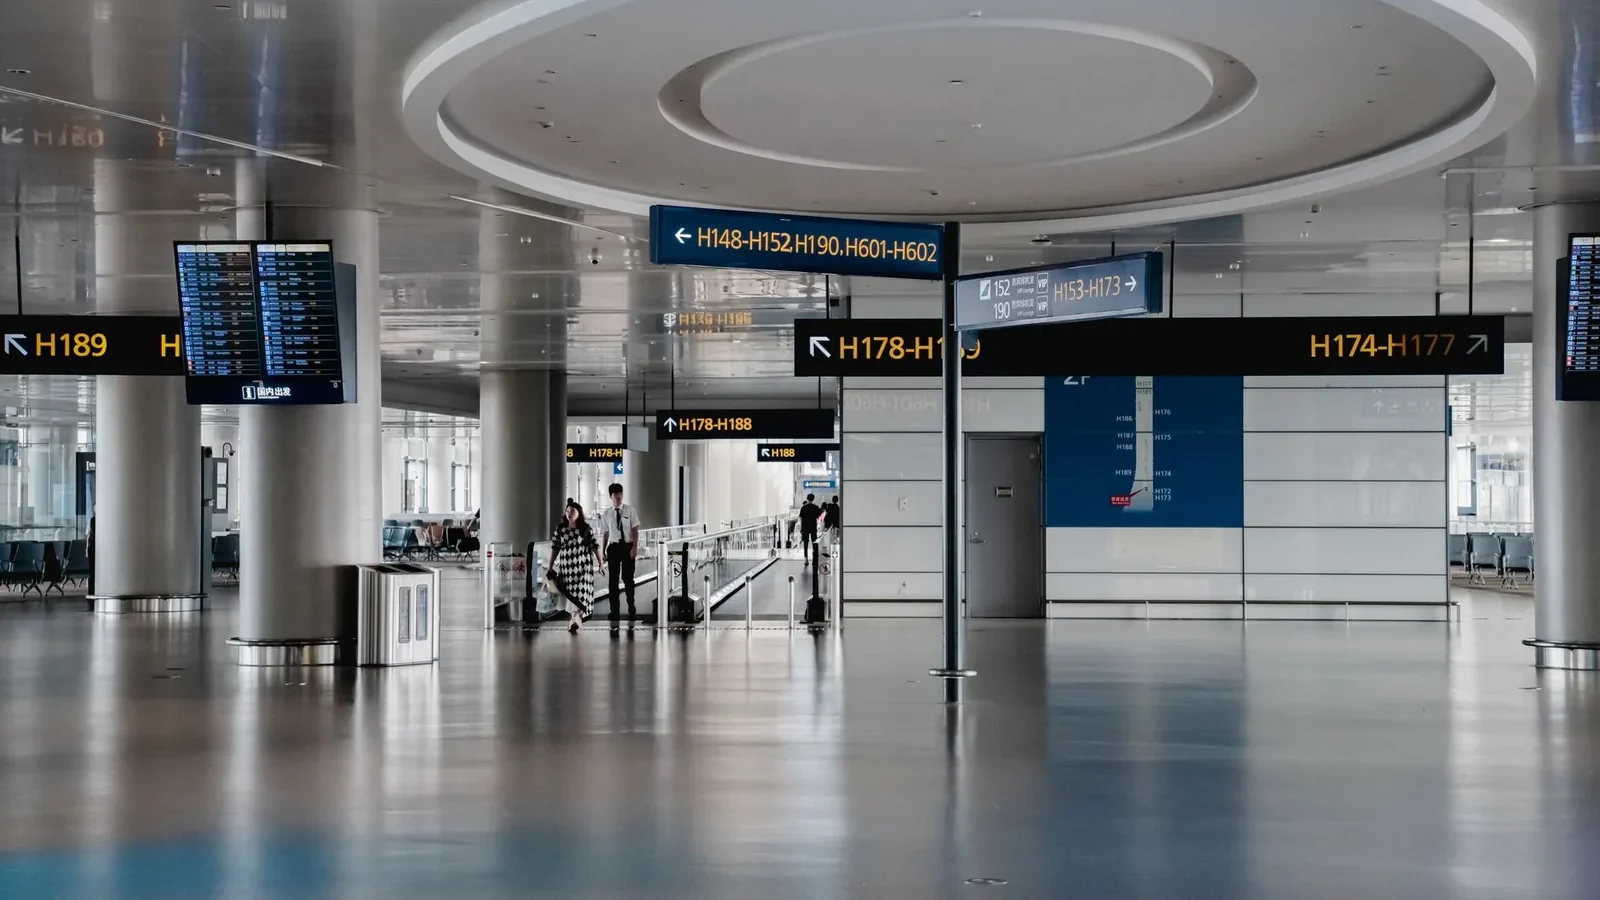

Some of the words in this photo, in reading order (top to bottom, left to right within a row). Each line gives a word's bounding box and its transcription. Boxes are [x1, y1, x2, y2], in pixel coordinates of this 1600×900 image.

[994, 279, 1010, 297] 152
[1037, 278, 1048, 289] VIP
[1054, 275, 1121, 302] H153-H173
[993, 302, 1010, 319] 190
[1037, 301, 1048, 312] VIP
[36, 333, 107, 357] H189
[1310, 333, 1456, 358] H174-H177
[257, 386, 291, 396] 国内出发
[679, 417, 752, 431] H178-H188
[589, 448, 623, 457] H178-H
[771, 448, 795, 458] H188
